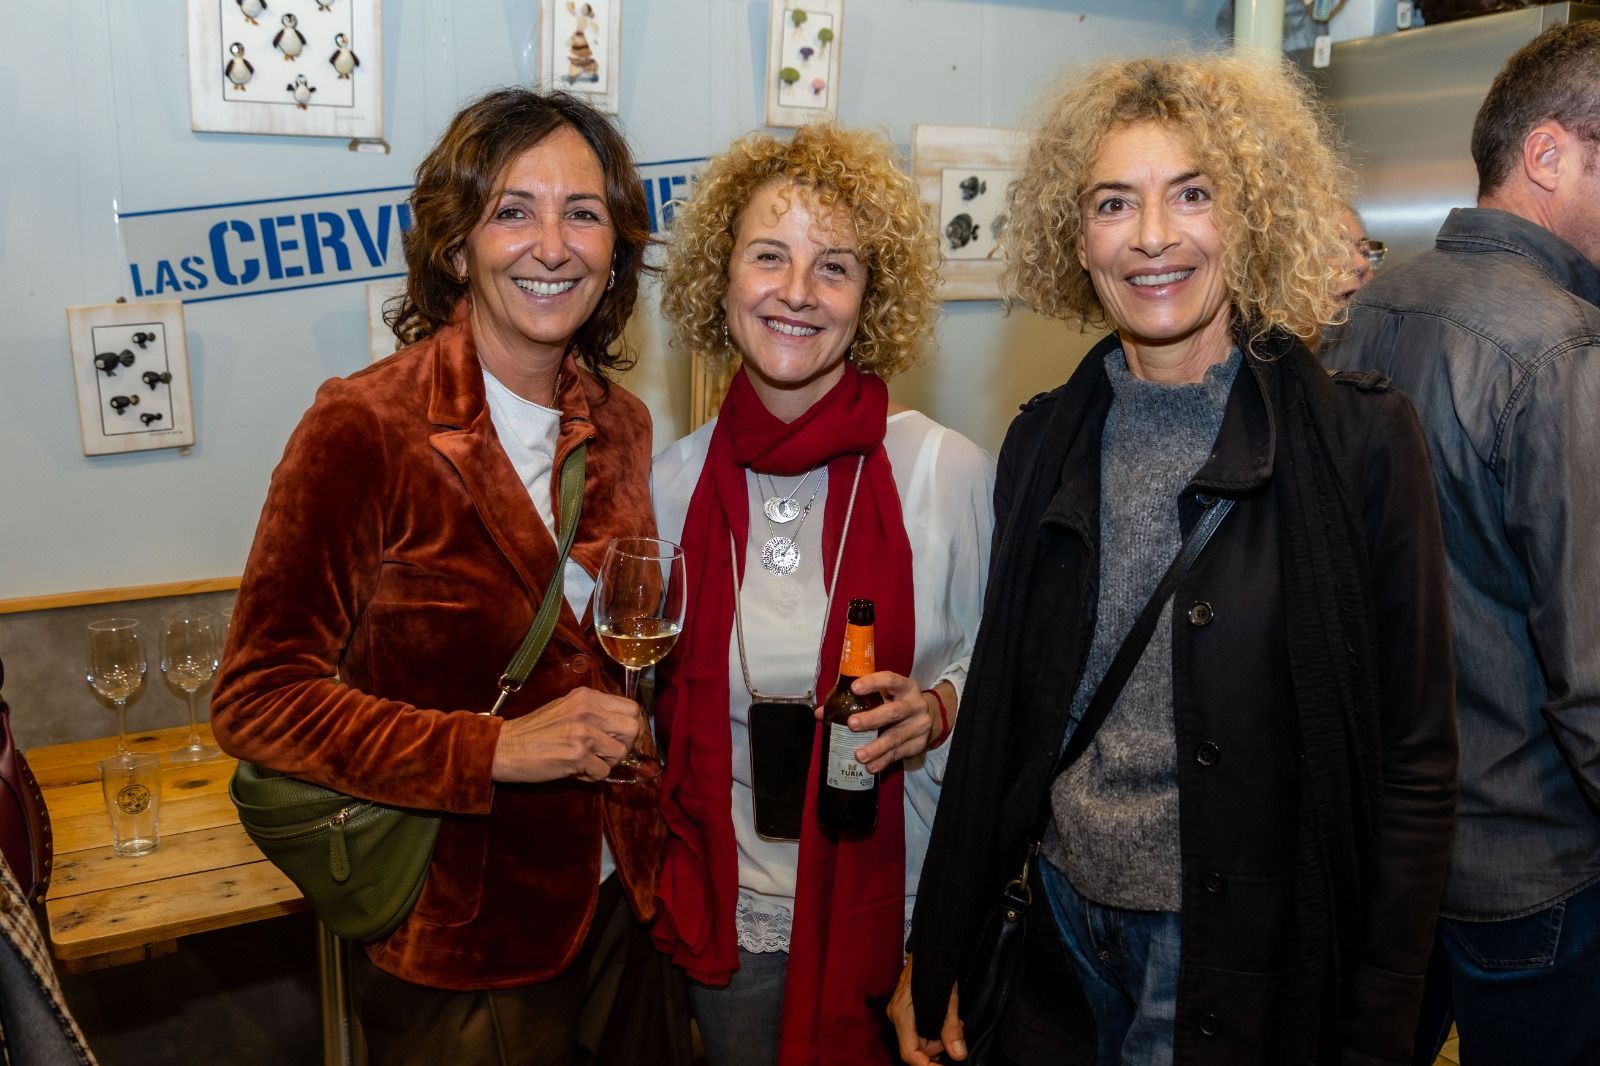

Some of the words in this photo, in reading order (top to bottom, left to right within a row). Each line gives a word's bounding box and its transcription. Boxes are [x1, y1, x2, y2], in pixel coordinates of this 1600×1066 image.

[129, 256, 209, 297] LAS
[208, 203, 412, 286] CERV
[840, 769, 863, 777] TURIA
